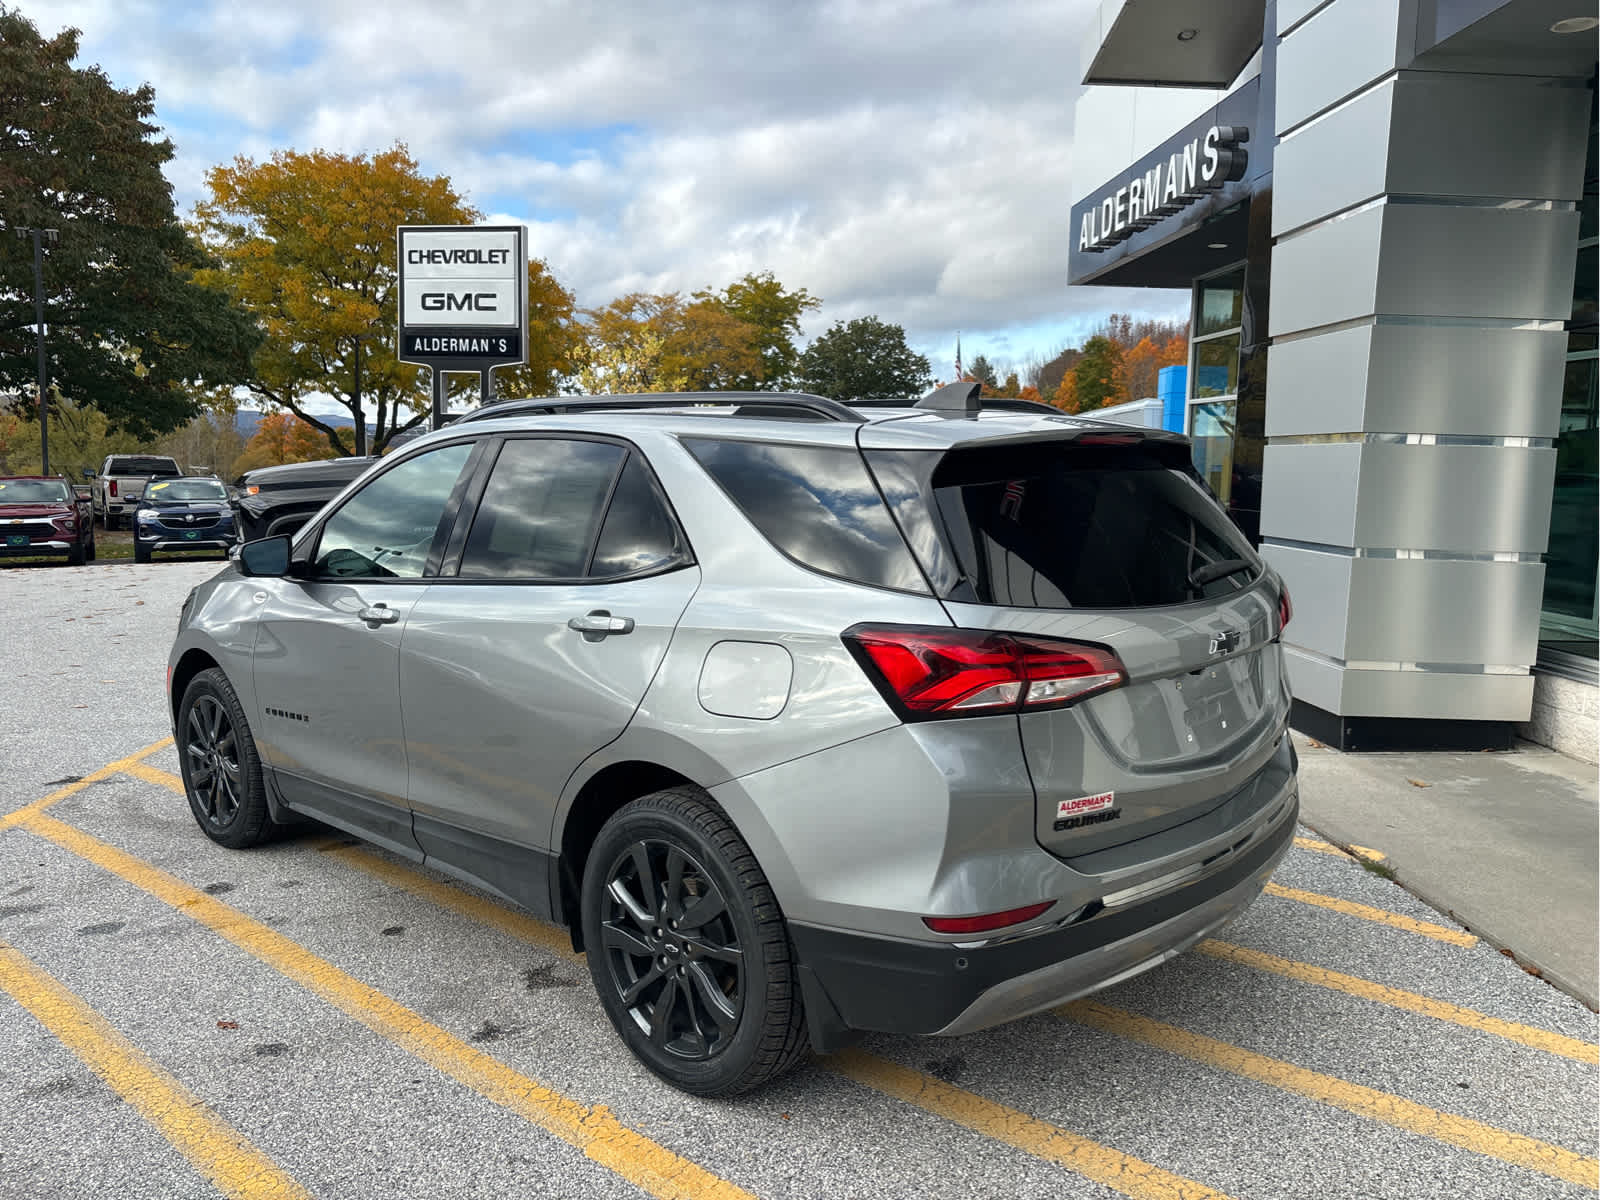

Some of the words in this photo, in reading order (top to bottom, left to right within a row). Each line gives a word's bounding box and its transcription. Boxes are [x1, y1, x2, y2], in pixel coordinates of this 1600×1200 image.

[408, 249, 510, 264] CHEVROLET
[421, 292, 497, 311] GMC
[414, 337, 507, 352] ALDERMAN'S
[1060, 794, 1112, 811] ALDERMAN'S
[1053, 807, 1121, 832] EQUINOX
